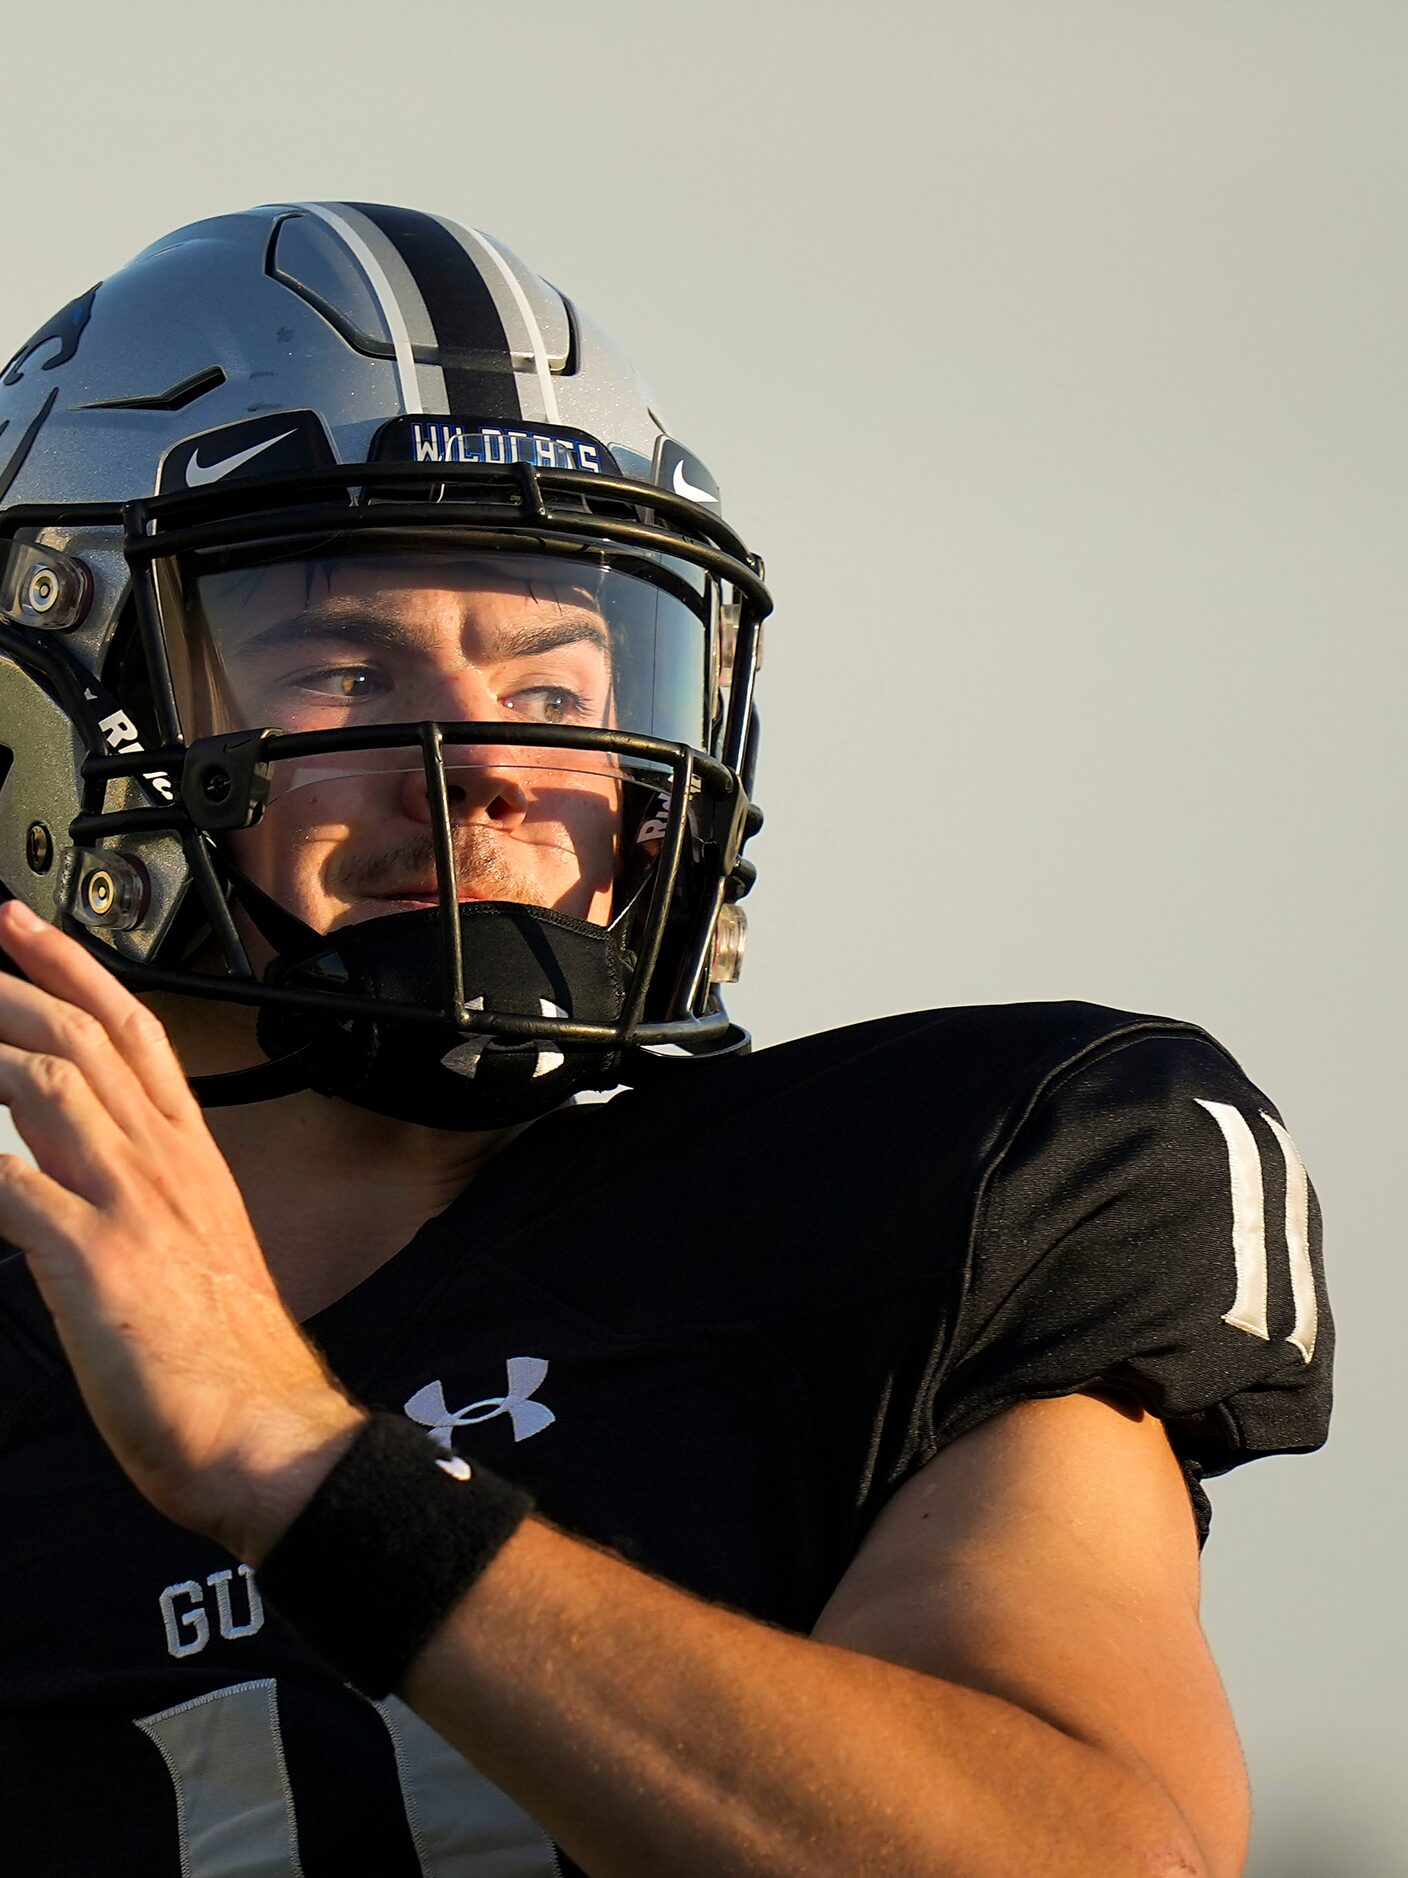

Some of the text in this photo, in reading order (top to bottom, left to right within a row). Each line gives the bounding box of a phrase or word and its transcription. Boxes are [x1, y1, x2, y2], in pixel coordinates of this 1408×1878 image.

[411, 422, 601, 473] WILDCATS
[1193, 1097, 1318, 1364] 11
[159, 1563, 265, 1658] GU
